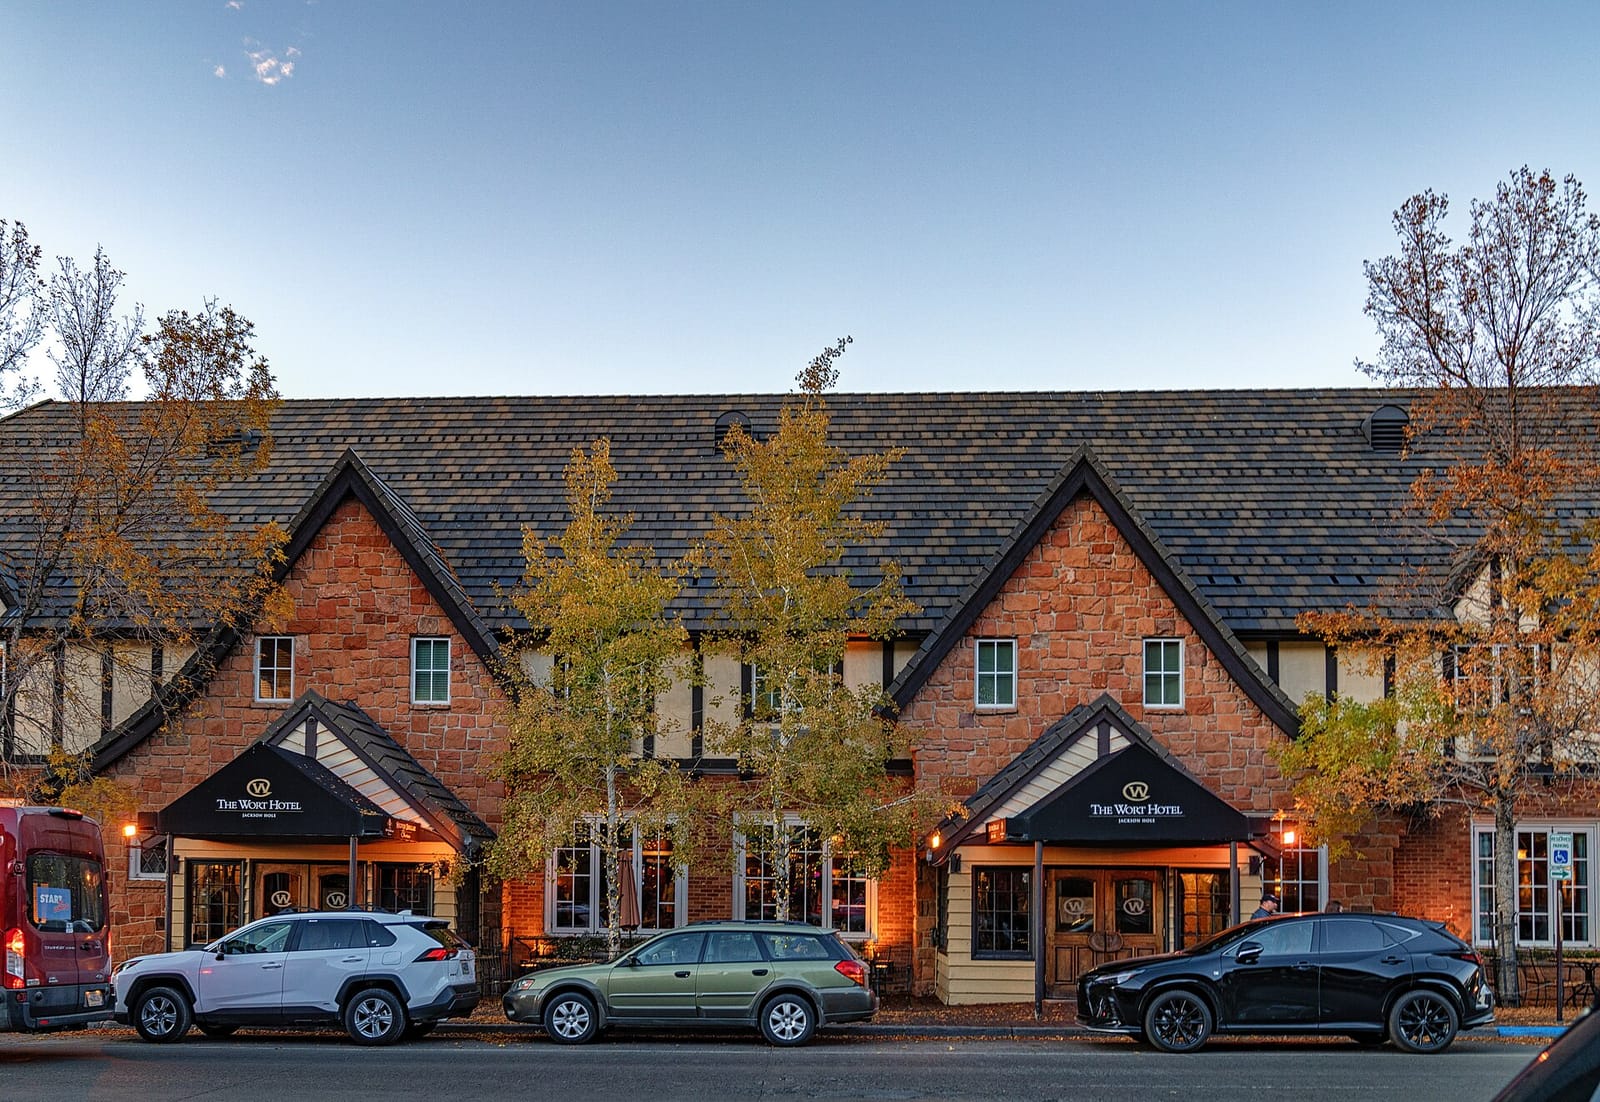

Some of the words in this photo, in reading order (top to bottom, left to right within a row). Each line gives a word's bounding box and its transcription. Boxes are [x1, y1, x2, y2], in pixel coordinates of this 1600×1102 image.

[216, 799, 238, 809] THE
[238, 799, 268, 810] WORT
[269, 799, 302, 810] HOTEL
[1090, 803, 1113, 815] THE
[1113, 803, 1146, 815] WORT
[1147, 803, 1183, 815] HOTEL
